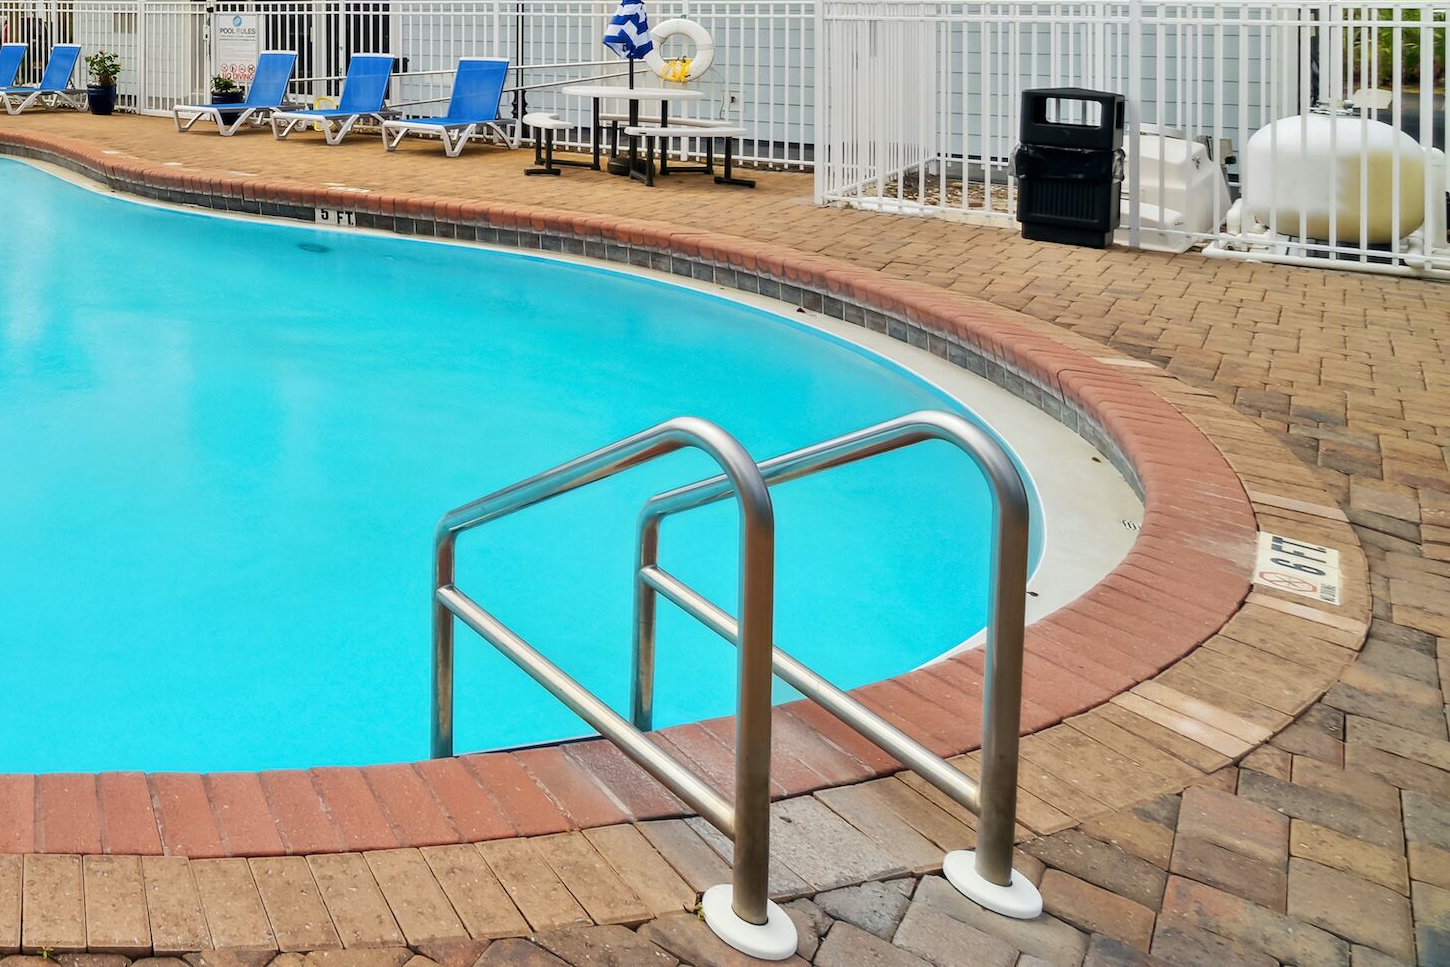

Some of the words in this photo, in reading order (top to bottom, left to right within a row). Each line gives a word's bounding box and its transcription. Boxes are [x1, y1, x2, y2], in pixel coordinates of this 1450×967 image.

[320, 208, 329, 220] 5
[336, 210, 354, 225] FT.
[1271, 535, 1327, 564] FT.
[1269, 557, 1327, 576] 6
